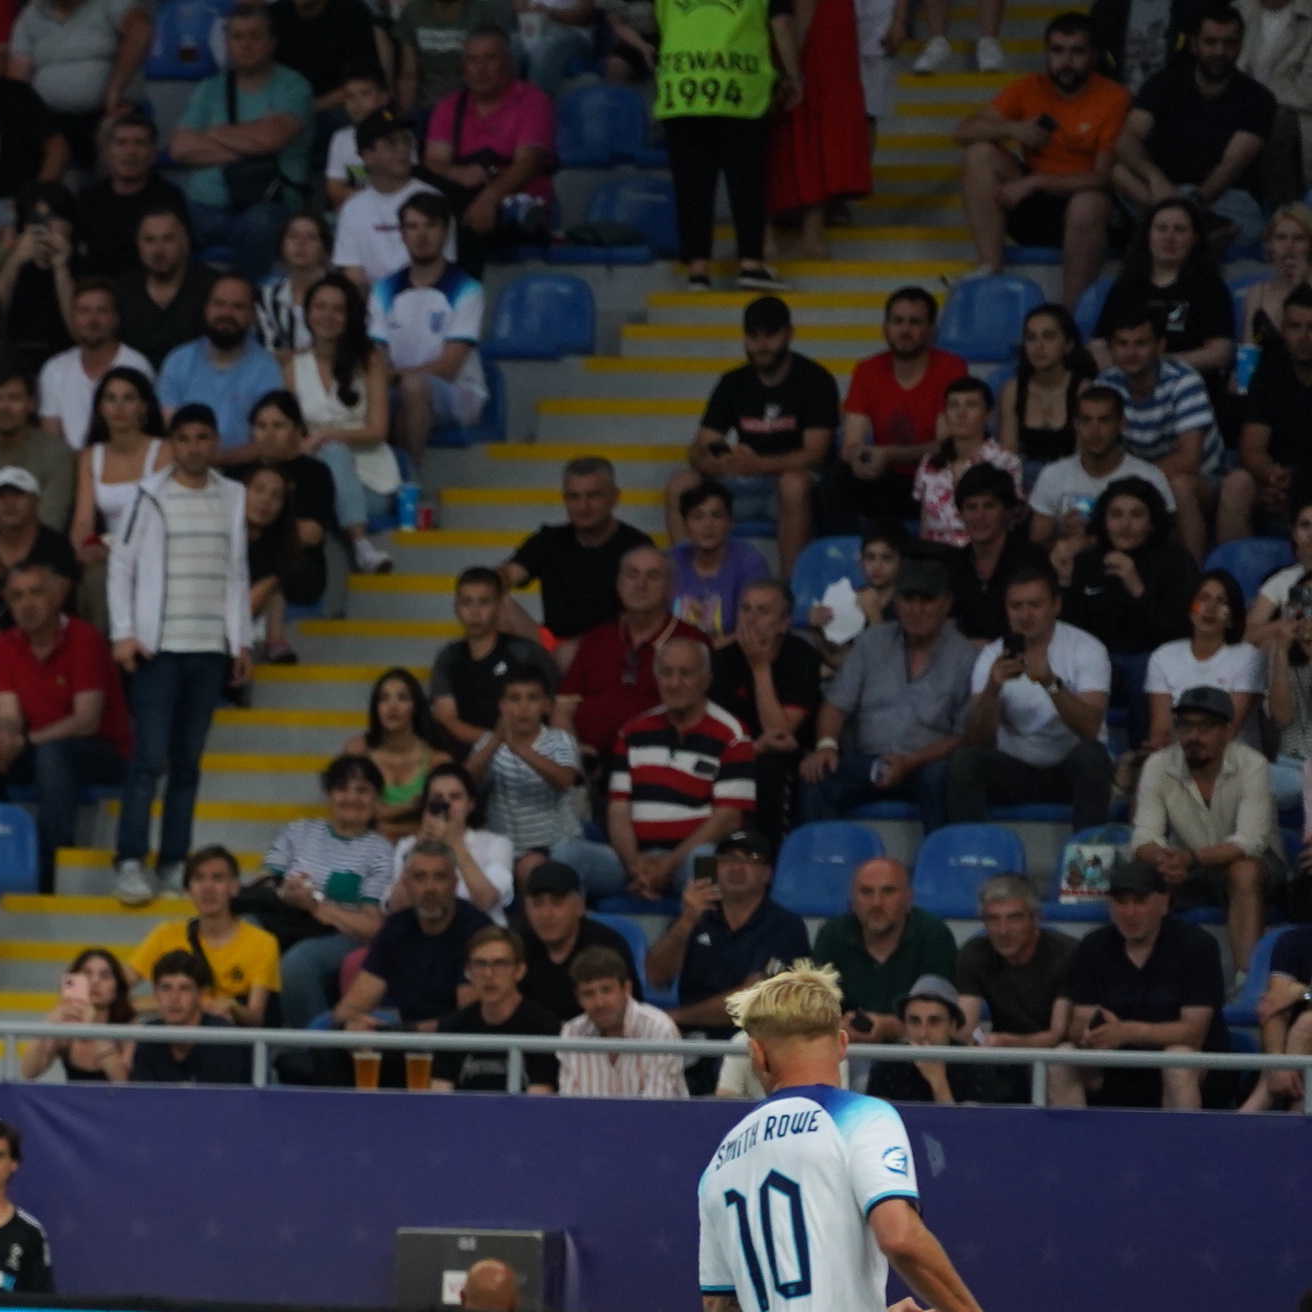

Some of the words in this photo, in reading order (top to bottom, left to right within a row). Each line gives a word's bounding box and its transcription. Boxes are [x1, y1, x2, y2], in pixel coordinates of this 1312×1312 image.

[660, 51, 760, 75] TEWARD
[664, 77, 742, 109] 1994
[764, 1109, 822, 1141] ROWE
[724, 1168, 811, 1312] 10
